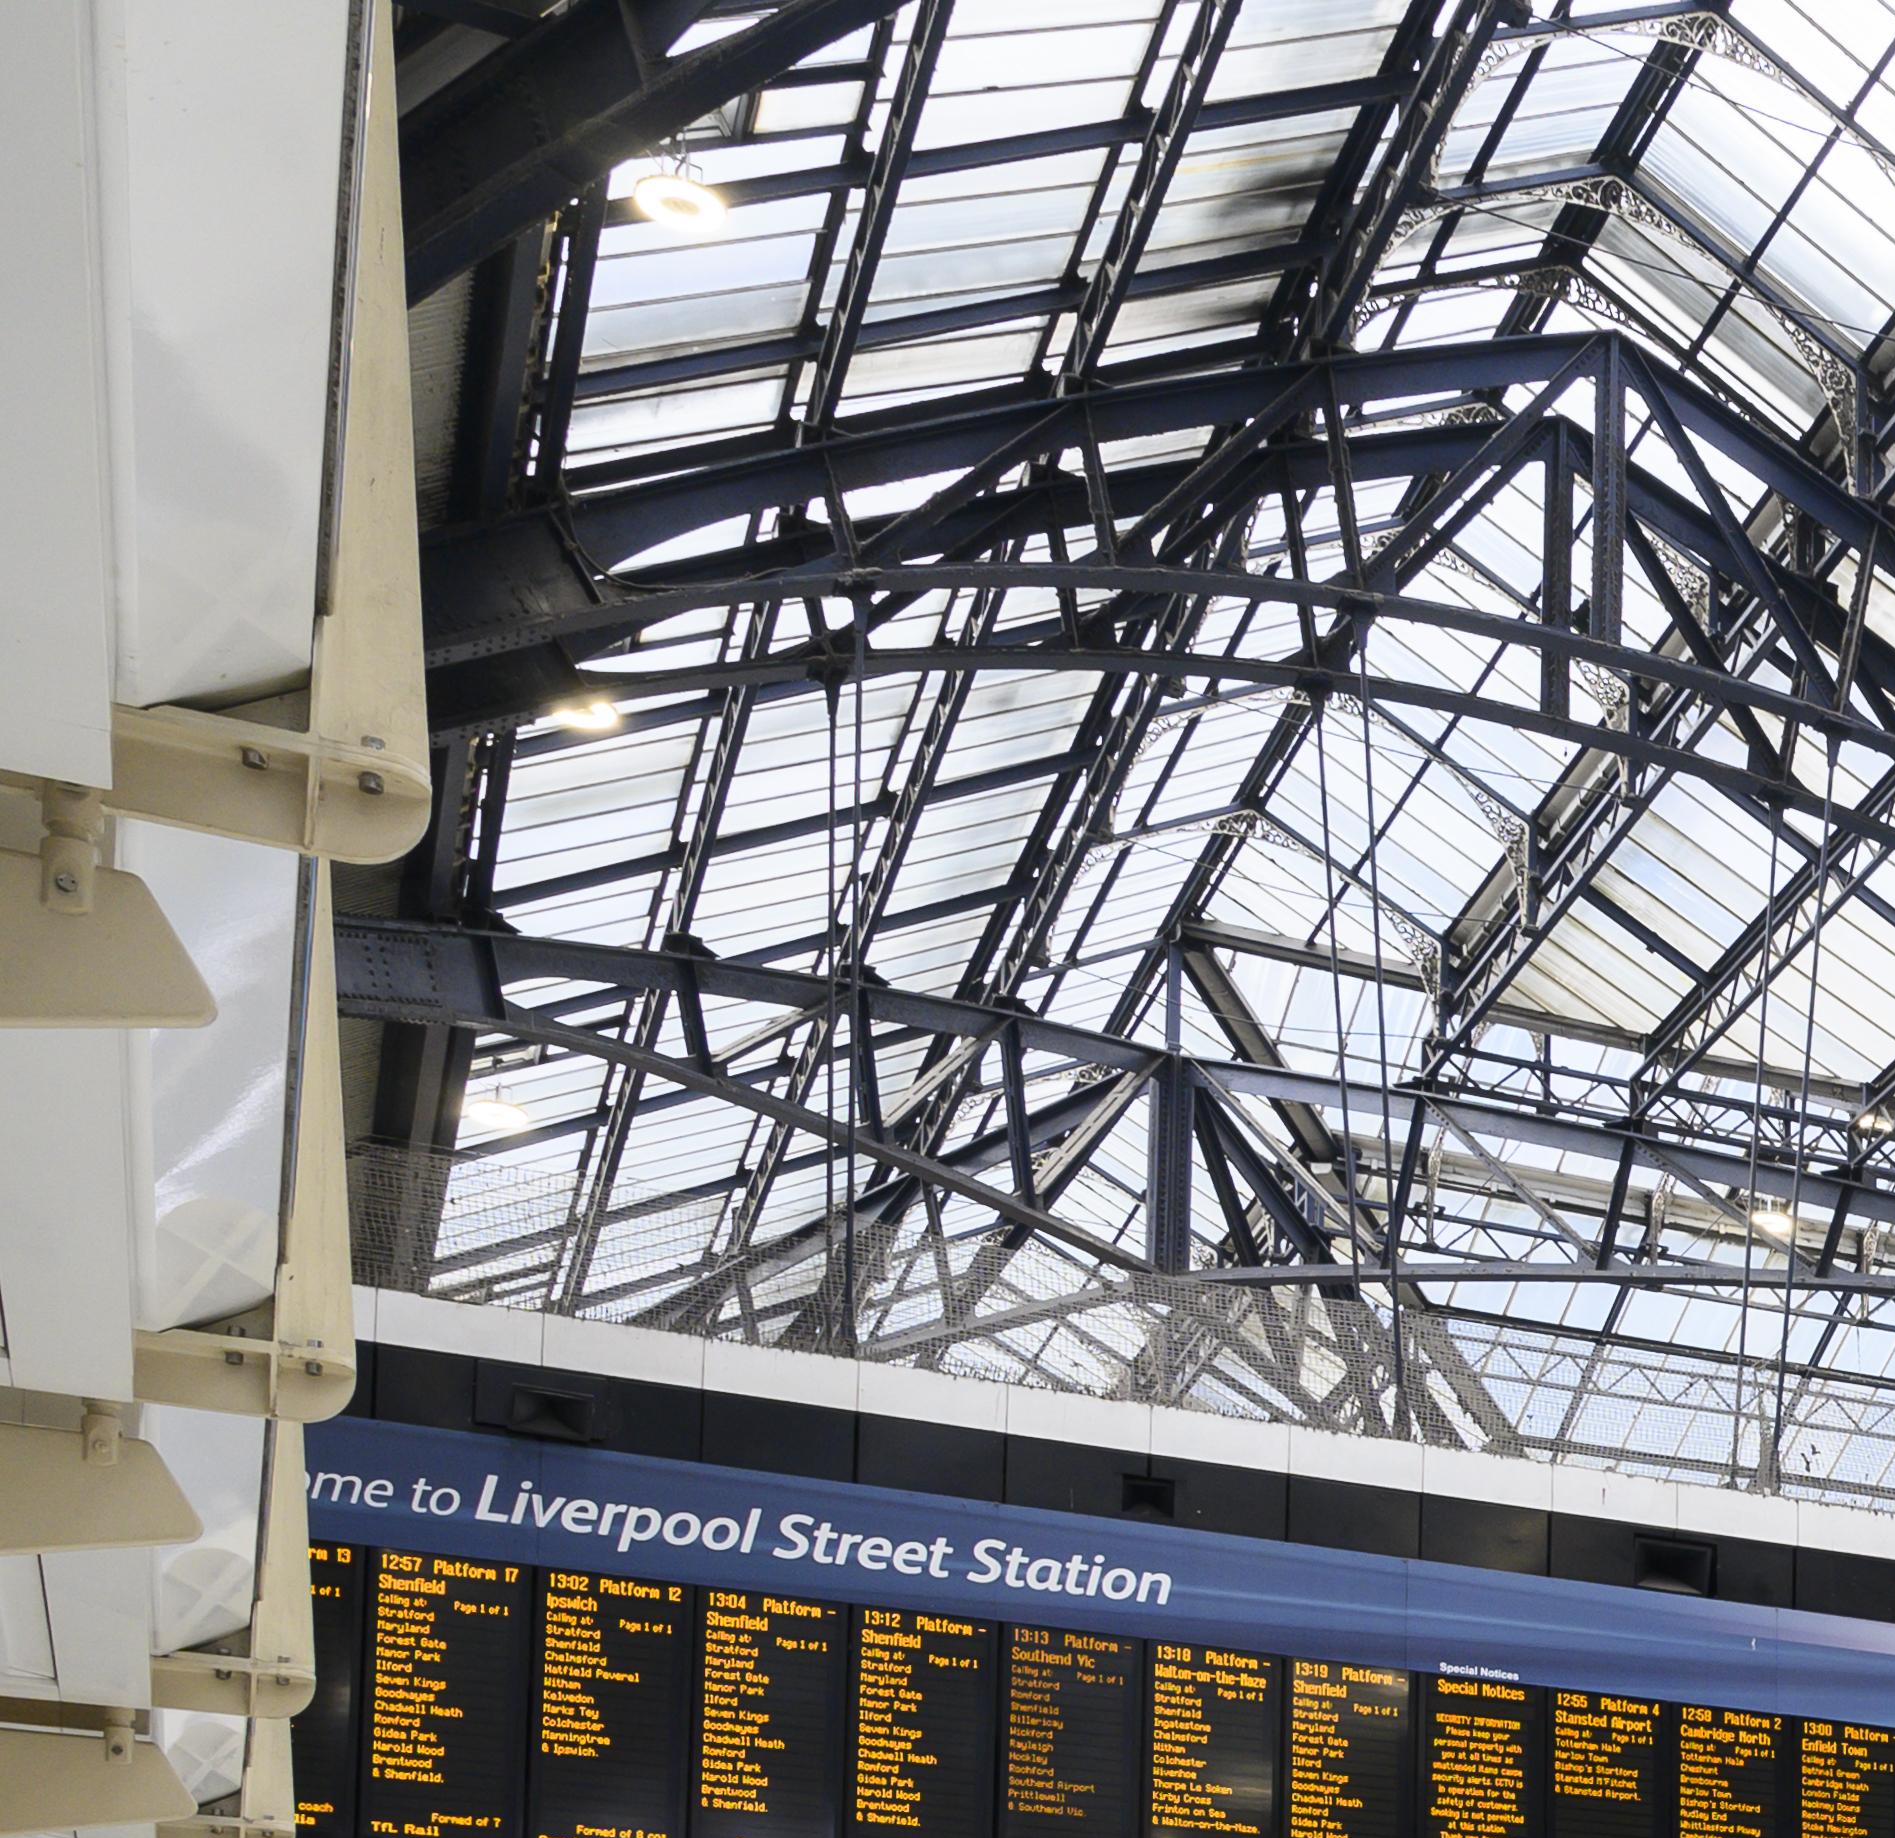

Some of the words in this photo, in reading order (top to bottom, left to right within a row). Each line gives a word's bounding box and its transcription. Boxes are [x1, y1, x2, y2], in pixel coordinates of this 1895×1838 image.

[412, 1478, 460, 1515] to
[475, 1475, 762, 1553] Liverpool
[773, 1514, 953, 1577] Street
[967, 1539, 1171, 1604] Station
[382, 1554, 422, 1572] 12:57
[434, 1560, 496, 1580] Platform
[505, 1568, 518, 1582] 17
[379, 1574, 445, 1595] Shenfield
[551, 1573, 588, 1591] 13:02
[600, 1579, 660, 1599] Platform
[669, 1587, 681, 1601] 12
[547, 1593, 597, 1611] Ipswich
[378, 1606, 434, 1621] Stratford
[377, 1659, 412, 1672] Ilford
[1440, 1662, 1478, 1675] Special
[1480, 1667, 1519, 1680] Notices
[1558, 1693, 1587, 1708] 12:55
[1601, 1698, 1648, 1714] Platform
[1652, 1704, 1659, 1716] 4
[543, 1716, 604, 1731] Colchester
[1555, 1710, 1607, 1727] Stansted
[1611, 1716, 1651, 1732] Airport
